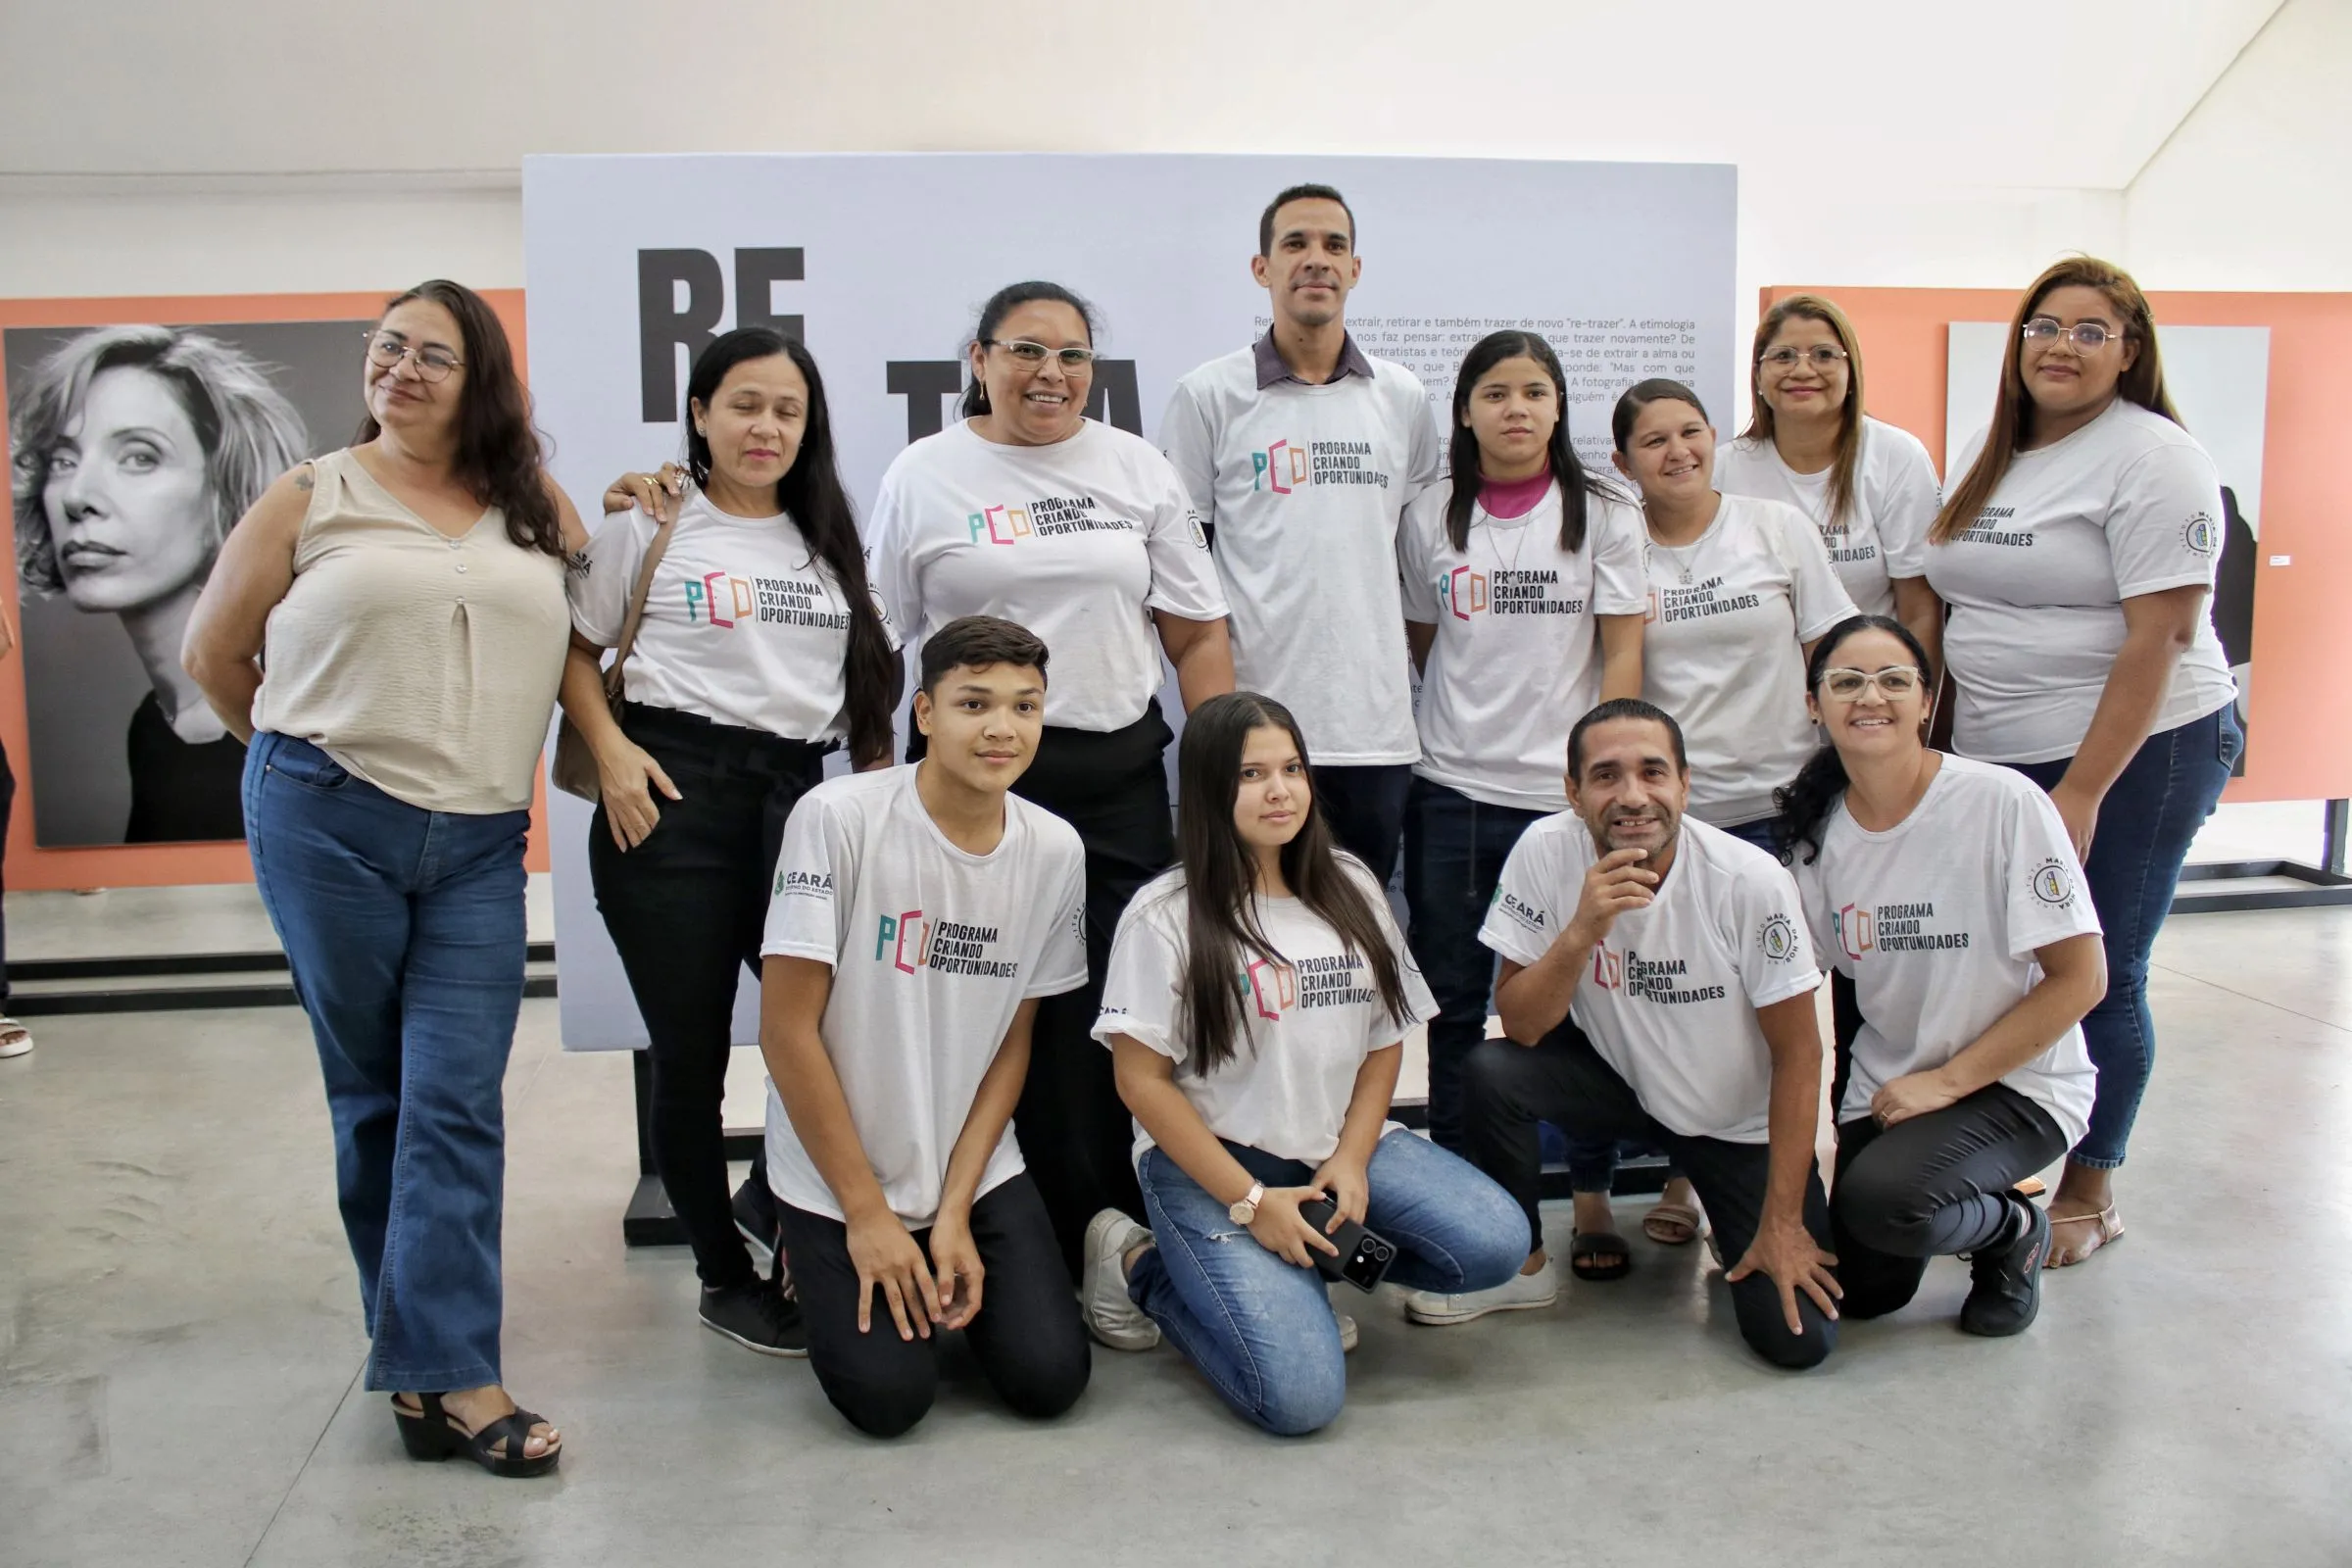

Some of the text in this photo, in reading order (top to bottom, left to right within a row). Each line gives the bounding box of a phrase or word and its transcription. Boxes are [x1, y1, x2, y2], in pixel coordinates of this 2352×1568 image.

[1346, 318, 1383, 327] extrair,
[1387, 318, 1420, 327] retirar
[1435, 318, 1481, 328] também
[1484, 319, 1517, 328] trazer
[1520, 318, 1534, 328] de
[1630, 319, 1638, 329] A
[1640, 319, 1695, 332] etimologia
[1382, 332, 1398, 342] faz
[1404, 334, 1446, 345] pensar:
[1548, 335, 1569, 345] que
[1574, 334, 1605, 344] trazer
[1610, 334, 1676, 345] novamente?
[1681, 335, 1695, 344] De
[1369, 347, 1427, 358] retratistas
[1586, 348, 1599, 358] de
[1603, 348, 1639, 359] extrair
[1652, 348, 1678, 359] alma
[1424, 363, 1445, 374] que
[1675, 365, 1695, 374] que
[1571, 378, 1579, 387] A
[1583, 377, 1635, 389] fotografia
[1311, 442, 1372, 456] PROGRAMA
[1313, 456, 1360, 470] CRIANDO
[1039, 520, 1133, 537] OPORTUNIDADES
[756, 578, 823, 597] PROGRAMA
[1494, 586, 1544, 600] CRIANDO
[1663, 576, 1725, 597] PROGRAMA
[759, 592, 812, 610] CRIANDO
[1494, 600, 1584, 614] OPORTUNIDADES
[1663, 590, 1714, 610] CRIANDO
[1665, 594, 1760, 622] OPORTUNIDADES
[760, 607, 851, 630] OPORTUNIDADES
[787, 871, 833, 889] CEARÁ
[1505, 894, 1544, 926] CEARÁ
[1878, 903, 1934, 920] PROGRAMA
[938, 921, 998, 943] PROGRAMA
[1878, 919, 1920, 936] CRIANDO
[933, 938, 983, 958] CRIANDO
[1880, 932, 1969, 953] OPORTUNIDADES
[929, 955, 1018, 978] OPORTUNIDADES
[1298, 955, 1364, 974] PROGRAMA
[1301, 971, 1351, 992] CRIANDO
